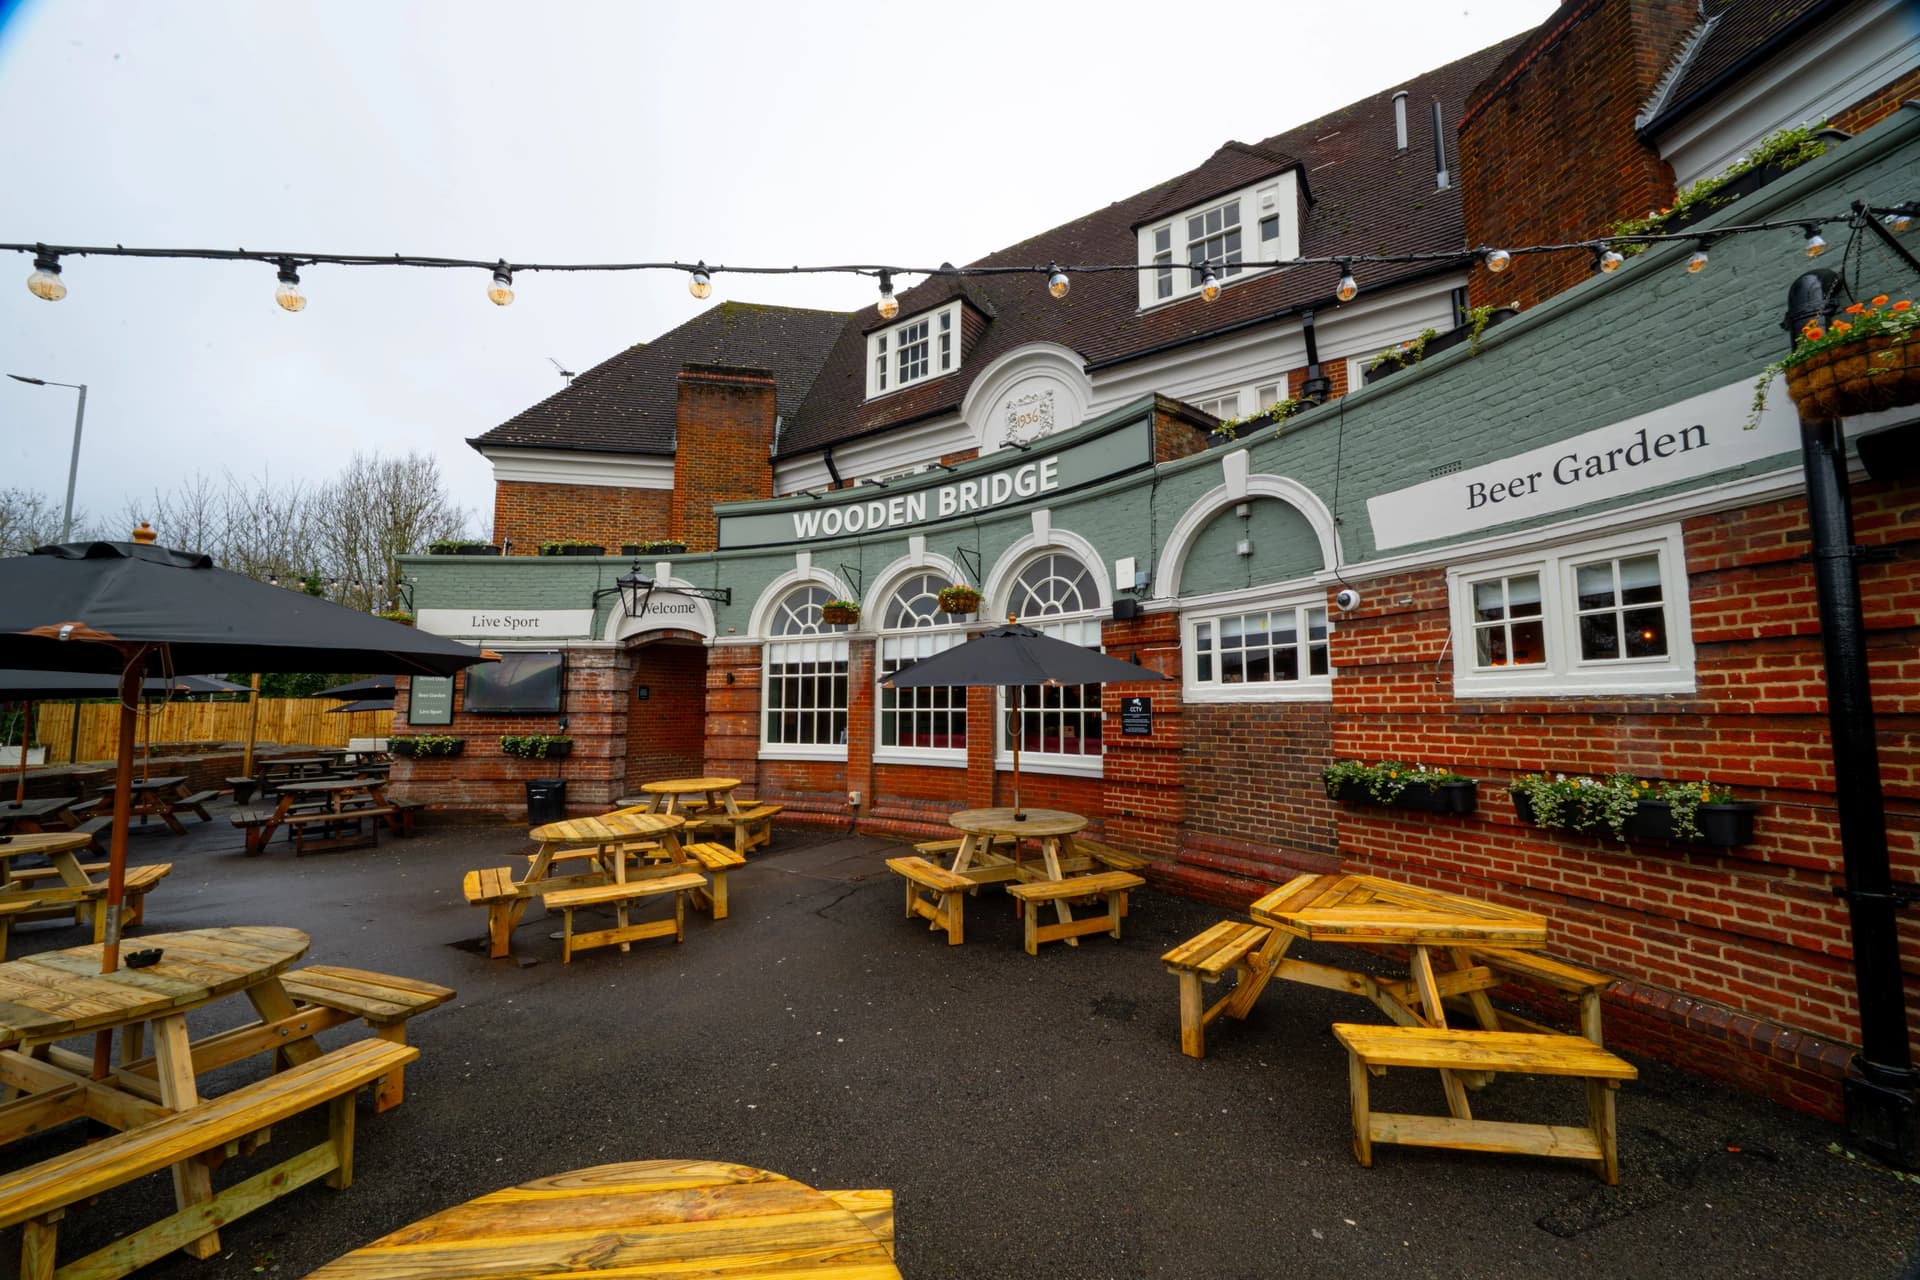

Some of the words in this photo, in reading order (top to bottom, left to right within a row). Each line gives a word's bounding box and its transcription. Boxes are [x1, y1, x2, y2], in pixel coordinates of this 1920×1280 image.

[1017, 408, 1039, 428] 1936
[1466, 471, 1542, 510] Beer
[1553, 423, 1710, 486] Garden
[793, 492, 926, 538] WOODEN
[938, 456, 1059, 516] BRIDGE
[640, 601, 696, 614] Welcome
[472, 615, 500, 628] Live
[503, 615, 540, 630] Sport
